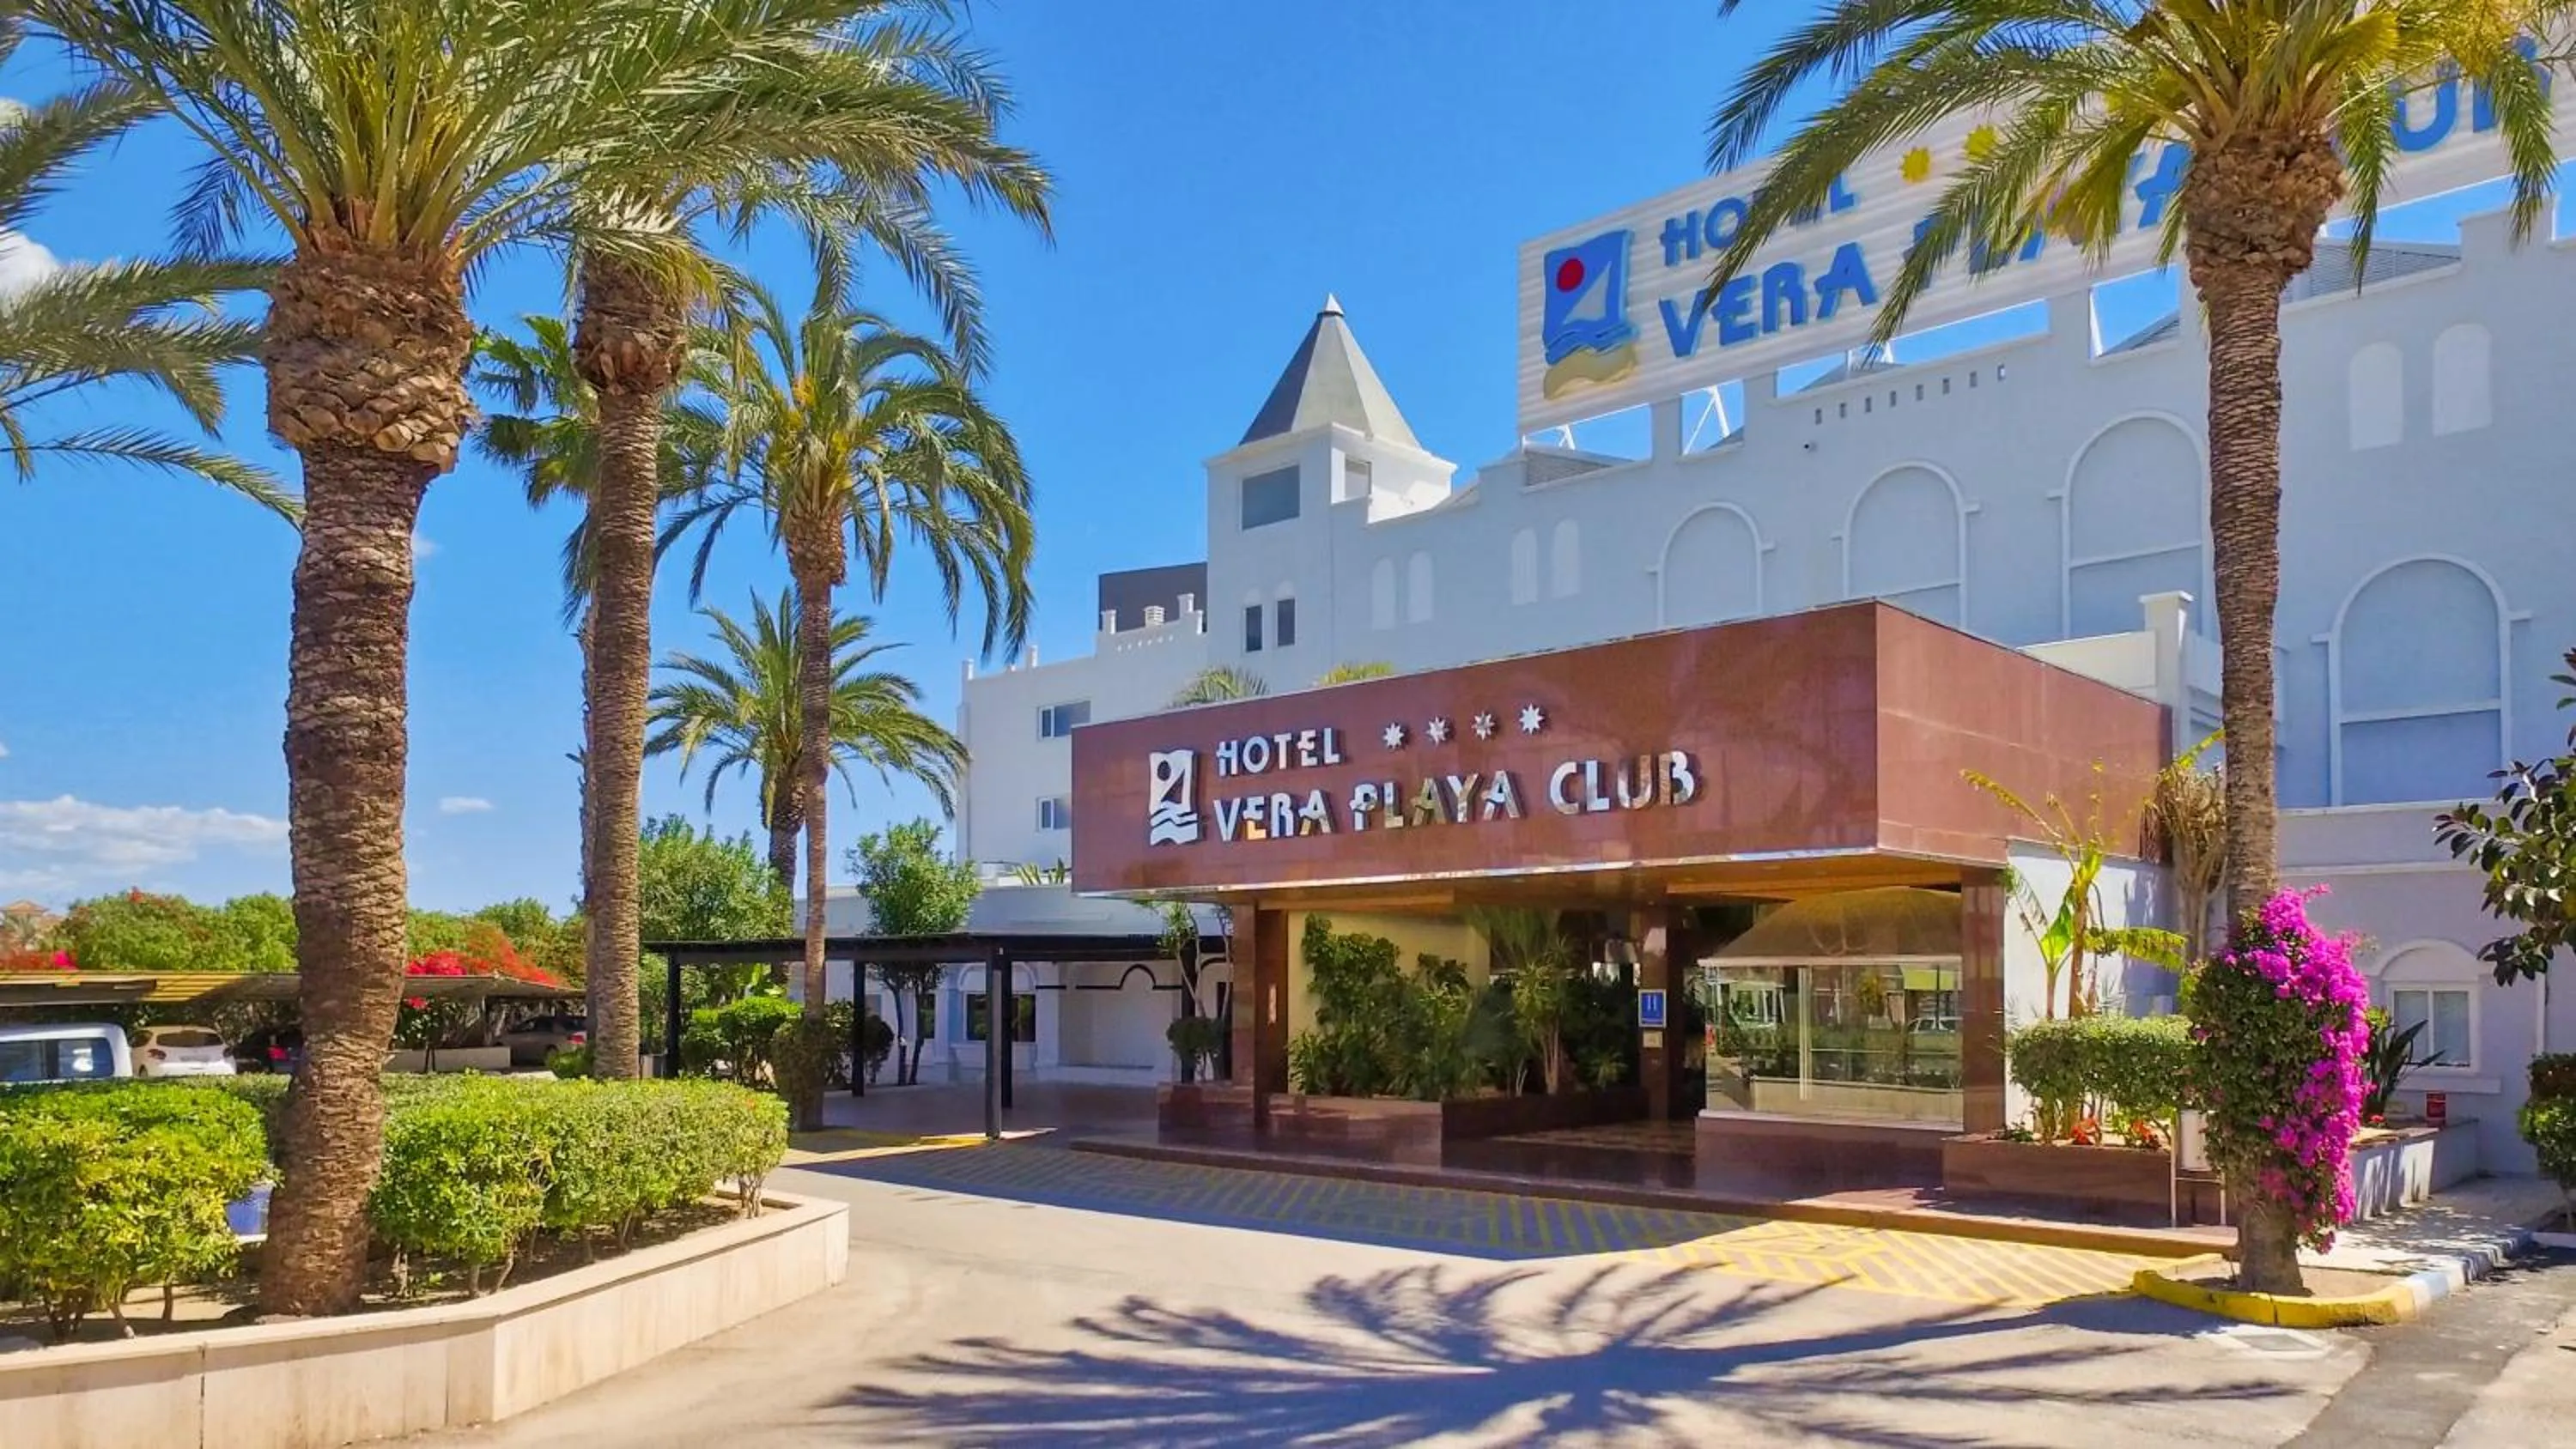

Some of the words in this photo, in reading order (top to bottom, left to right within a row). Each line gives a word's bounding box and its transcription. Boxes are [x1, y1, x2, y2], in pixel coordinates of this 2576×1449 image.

[1659, 172, 1856, 267] HOL
[1658, 242, 1878, 358] VERA
[1213, 789, 1332, 841] VERA
[1350, 769, 1521, 831] PLAYA
[1550, 750, 1695, 815] CLUB
[1216, 727, 1341, 777] HOTEL
